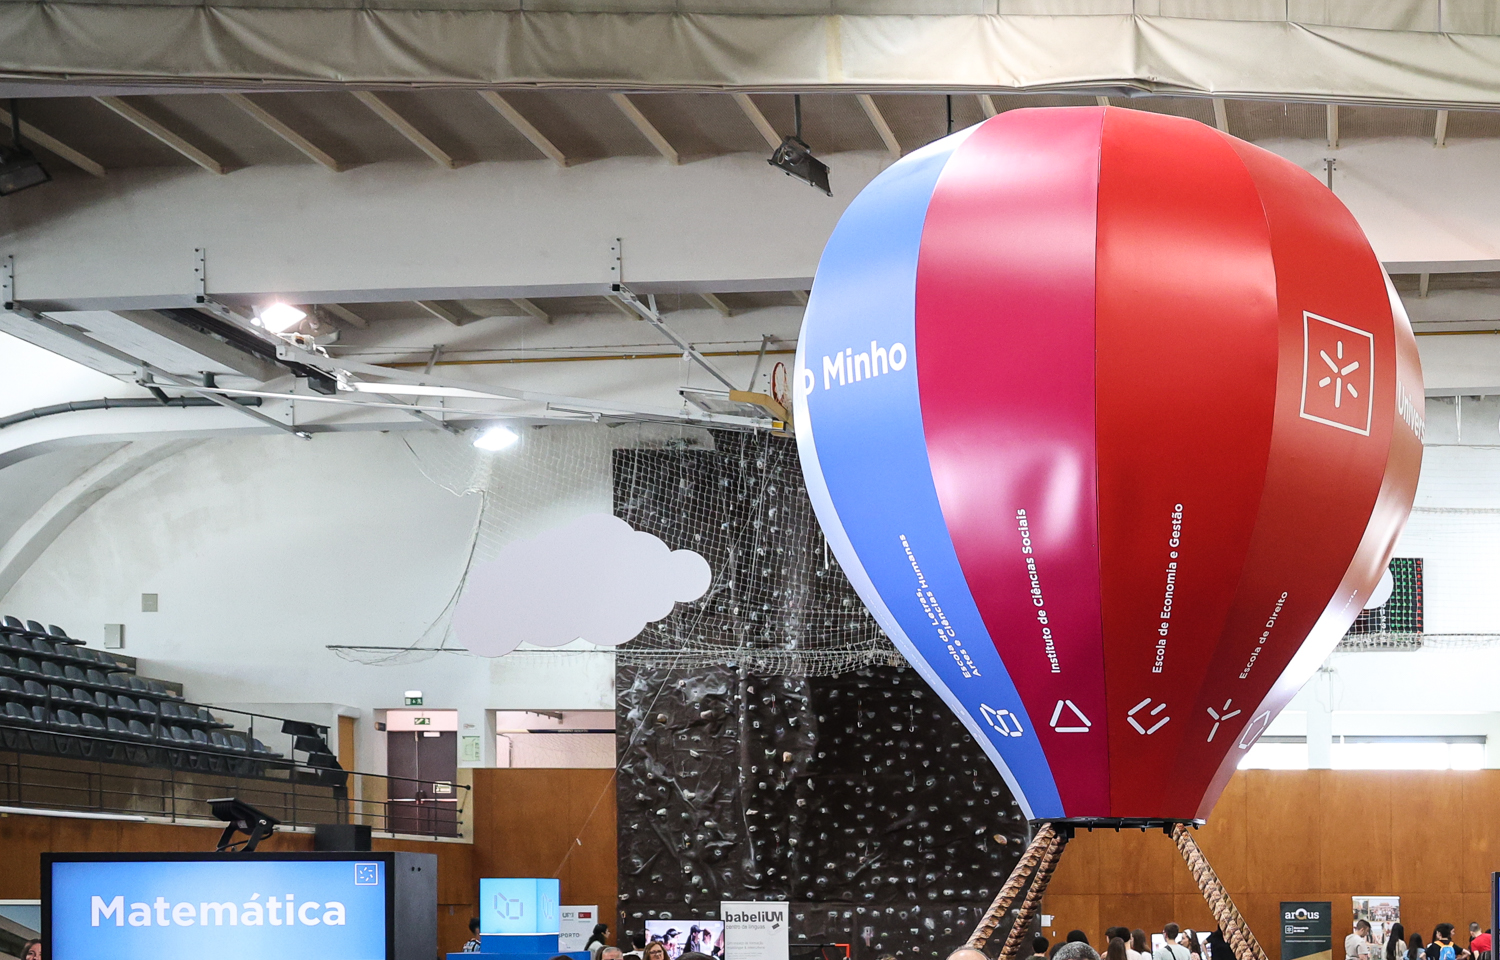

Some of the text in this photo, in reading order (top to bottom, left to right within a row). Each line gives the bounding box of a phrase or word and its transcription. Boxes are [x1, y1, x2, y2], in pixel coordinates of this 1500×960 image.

[822, 340, 907, 391] Minho
[1397, 381, 1426, 445] Univers
[899, 534, 929, 589] Humanas
[926, 590, 956, 637] Ciências
[1015, 508, 1061, 673] Instituto de Ciências Sociais
[1151, 503, 1184, 674] Escola de Economia e Gestão
[916, 588, 973, 679] Escola de Letras,
[954, 639, 962, 647] e
[1238, 591, 1288, 679] Escola de Direito
[959, 648, 982, 677] Artes
[91, 892, 346, 927] Matemática
[725, 911, 784, 923] babeliUM
